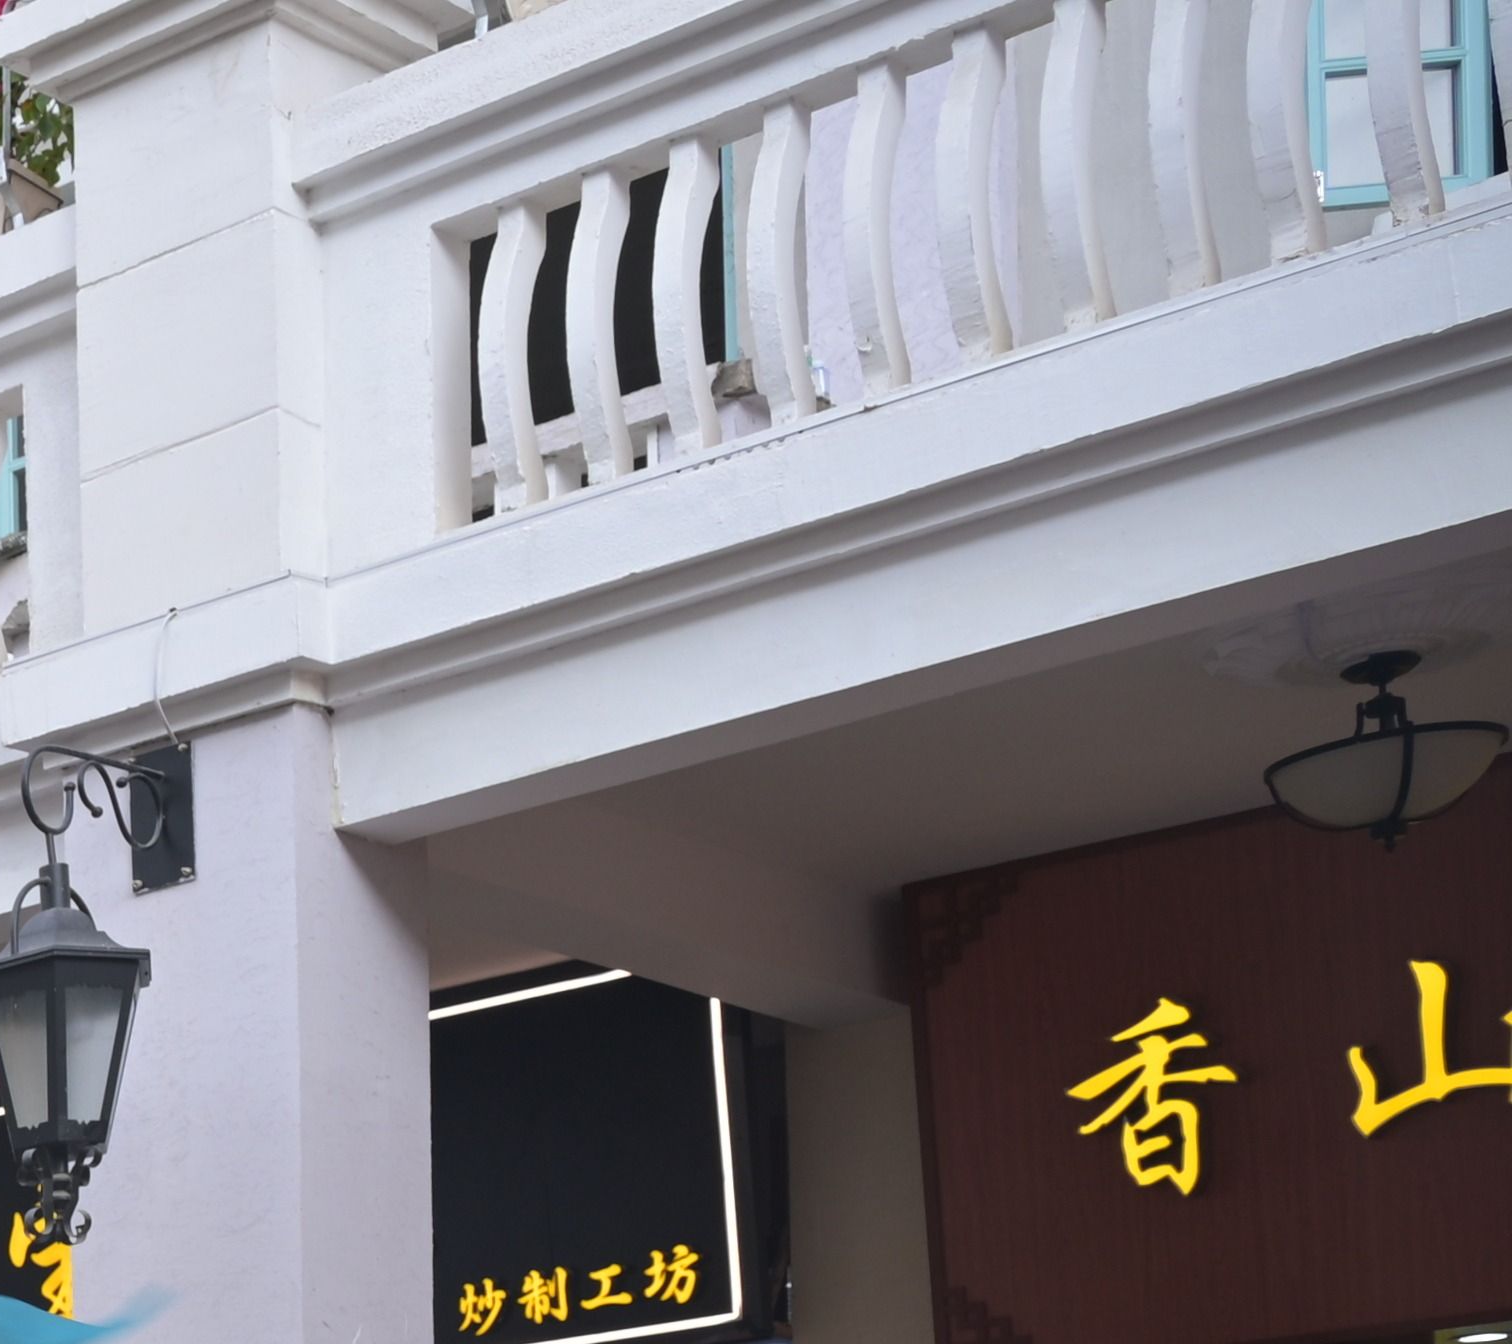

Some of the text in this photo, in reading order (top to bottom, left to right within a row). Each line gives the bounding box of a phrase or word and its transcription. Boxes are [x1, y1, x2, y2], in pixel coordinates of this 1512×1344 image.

[1065, 959, 1512, 1196] 香山
[459, 1244, 701, 1336] 炒制工坊
